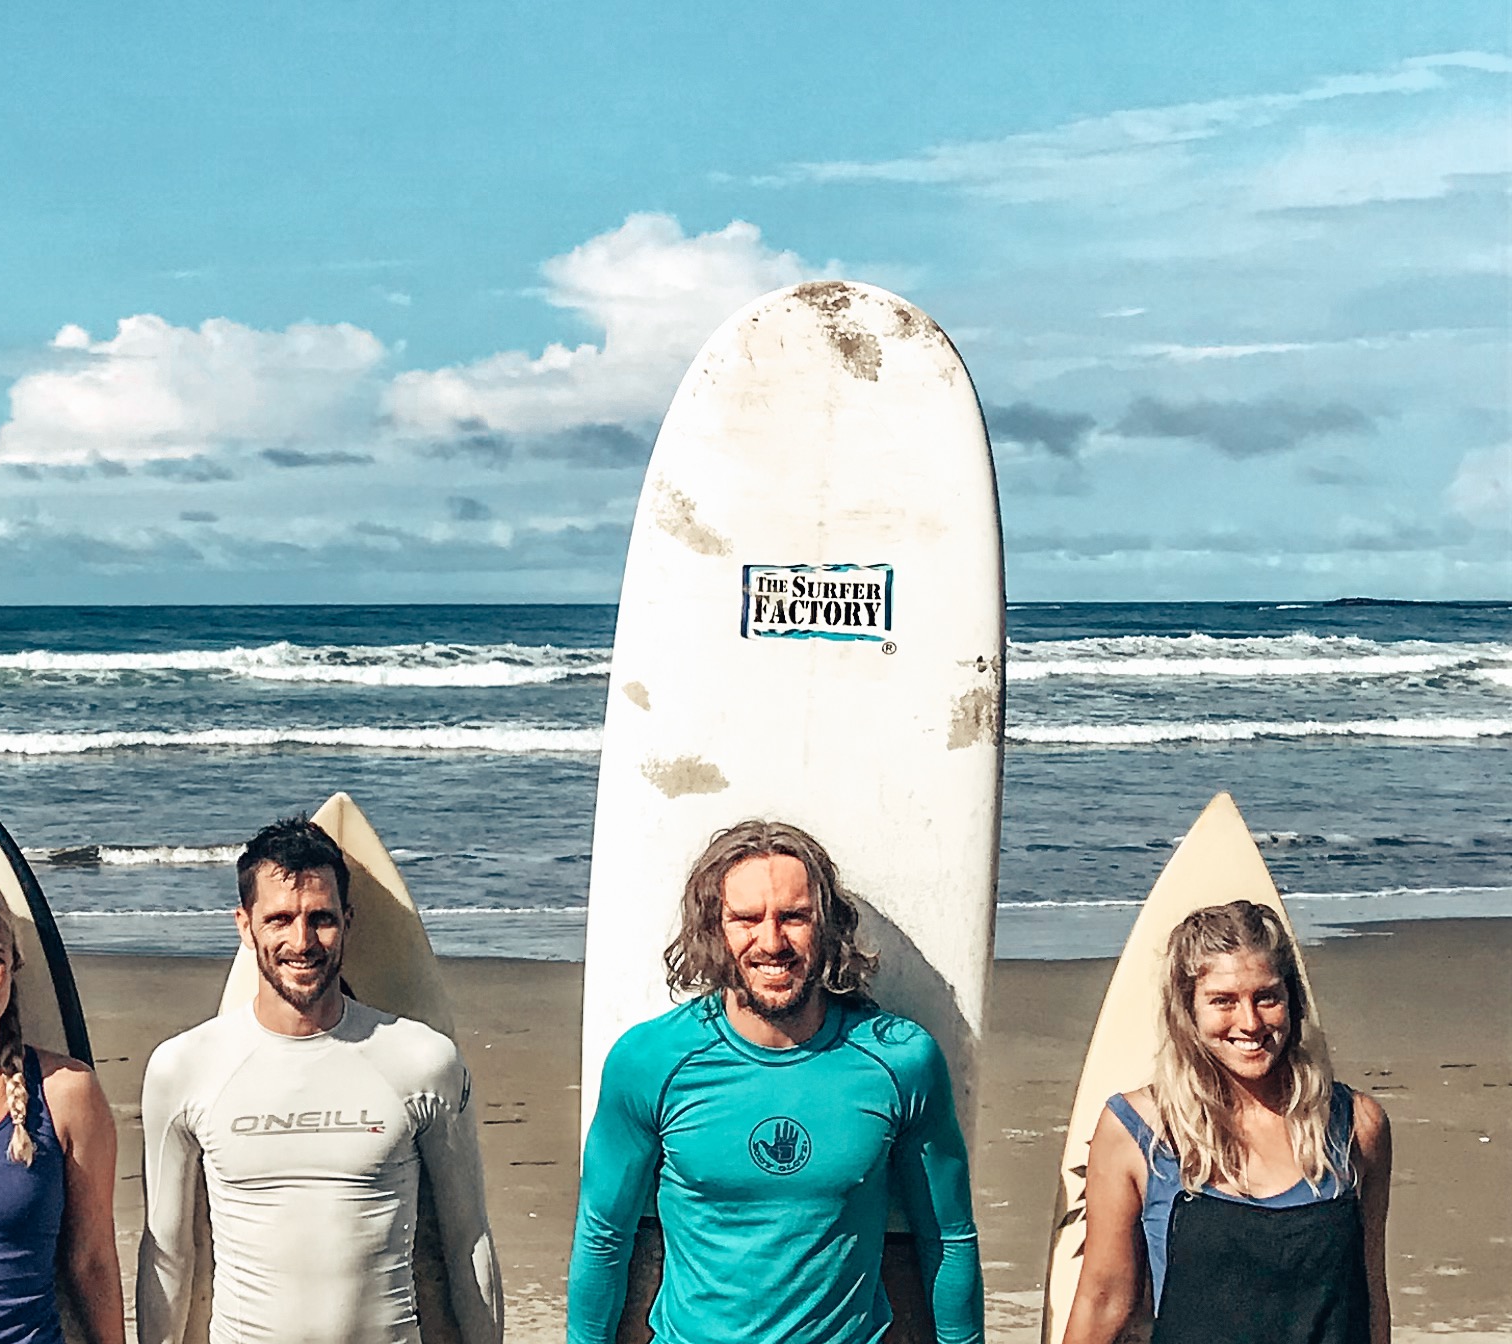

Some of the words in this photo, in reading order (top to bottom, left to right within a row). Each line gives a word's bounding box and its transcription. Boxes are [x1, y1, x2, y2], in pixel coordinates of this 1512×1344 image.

[755, 576, 788, 593] THE
[792, 576, 881, 600] SURFER
[753, 594, 881, 627] FACTORY
[230, 1109, 384, 1133] O'NEILL
